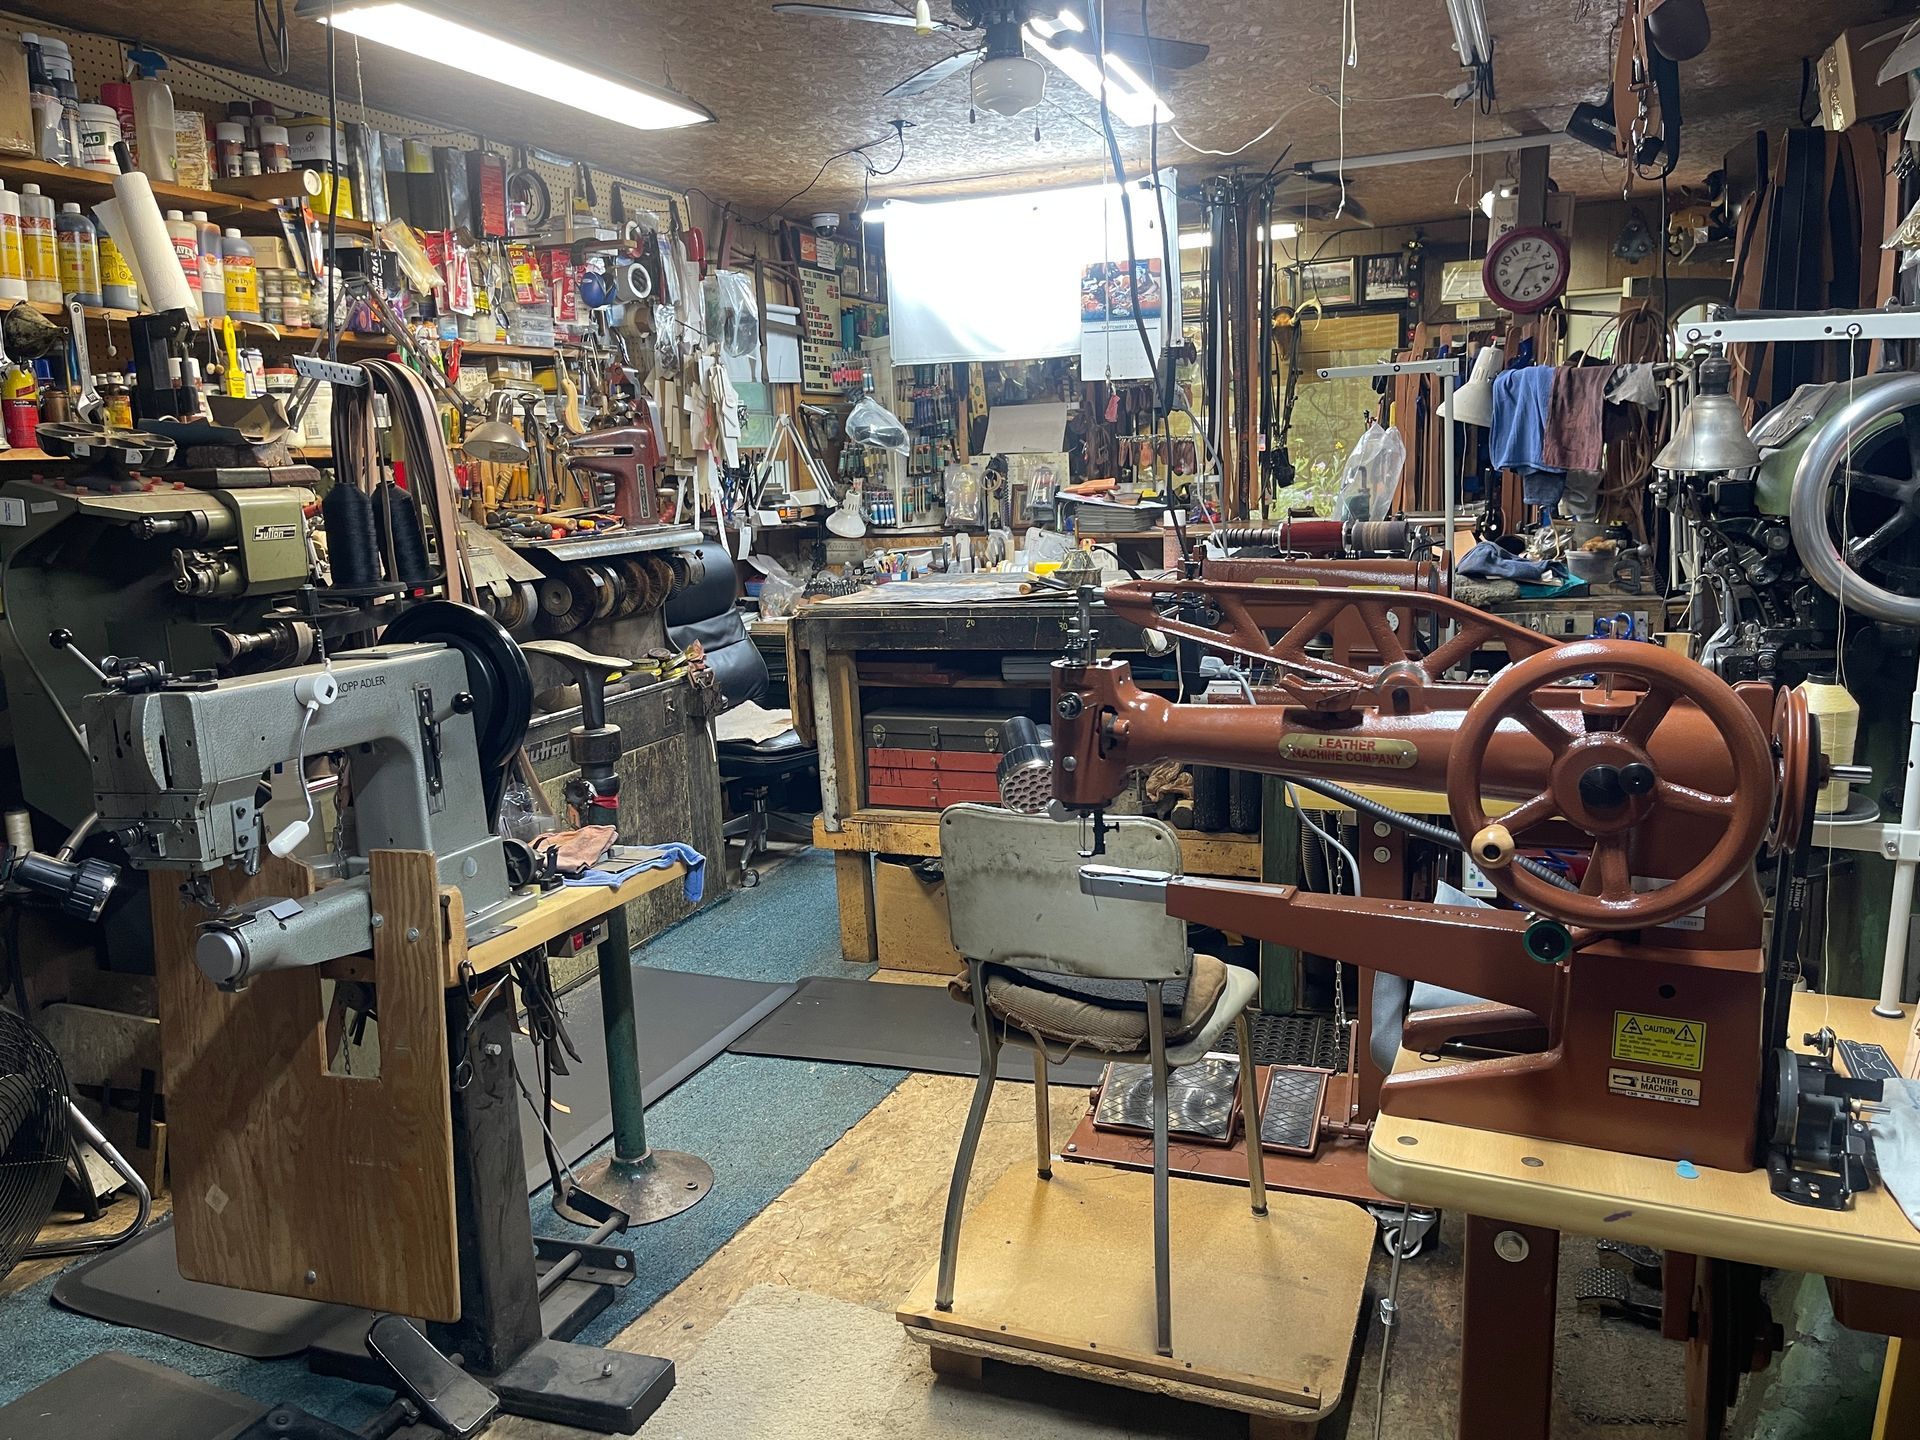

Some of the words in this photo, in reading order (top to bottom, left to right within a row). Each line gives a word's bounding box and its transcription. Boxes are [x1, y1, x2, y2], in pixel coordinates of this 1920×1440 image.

[1510, 247, 1519, 257] 11
[1521, 242, 1531, 252] 12
[1535, 244, 1541, 253] 1
[1501, 255, 1512, 267] 10
[1542, 251, 1551, 261] 2
[1545, 262, 1554, 271] 3
[1499, 269, 1508, 277] 9
[1502, 279, 1511, 287] 8
[1542, 275, 1551, 284] 4
[1522, 287, 1530, 297] 6
[1534, 283, 1542, 293] 5
[256, 526, 284, 540] Sutton
[965, 619, 976, 628] 20
[1059, 621, 1068, 631] 30
[338, 681, 358, 693] KOPP
[360, 675, 386, 689] ADLER
[1318, 737, 1376, 751] LEATHER
[529, 741, 569, 762] utton
[1293, 748, 1342, 761] MACHINE
[1345, 751, 1402, 765] COMPANY
[1643, 1024, 1676, 1035] CAUTION
[1641, 1075, 1678, 1086] LEATHER
[1640, 1083, 1679, 1095] MACHINE
[1681, 1088, 1696, 1097] CO.
